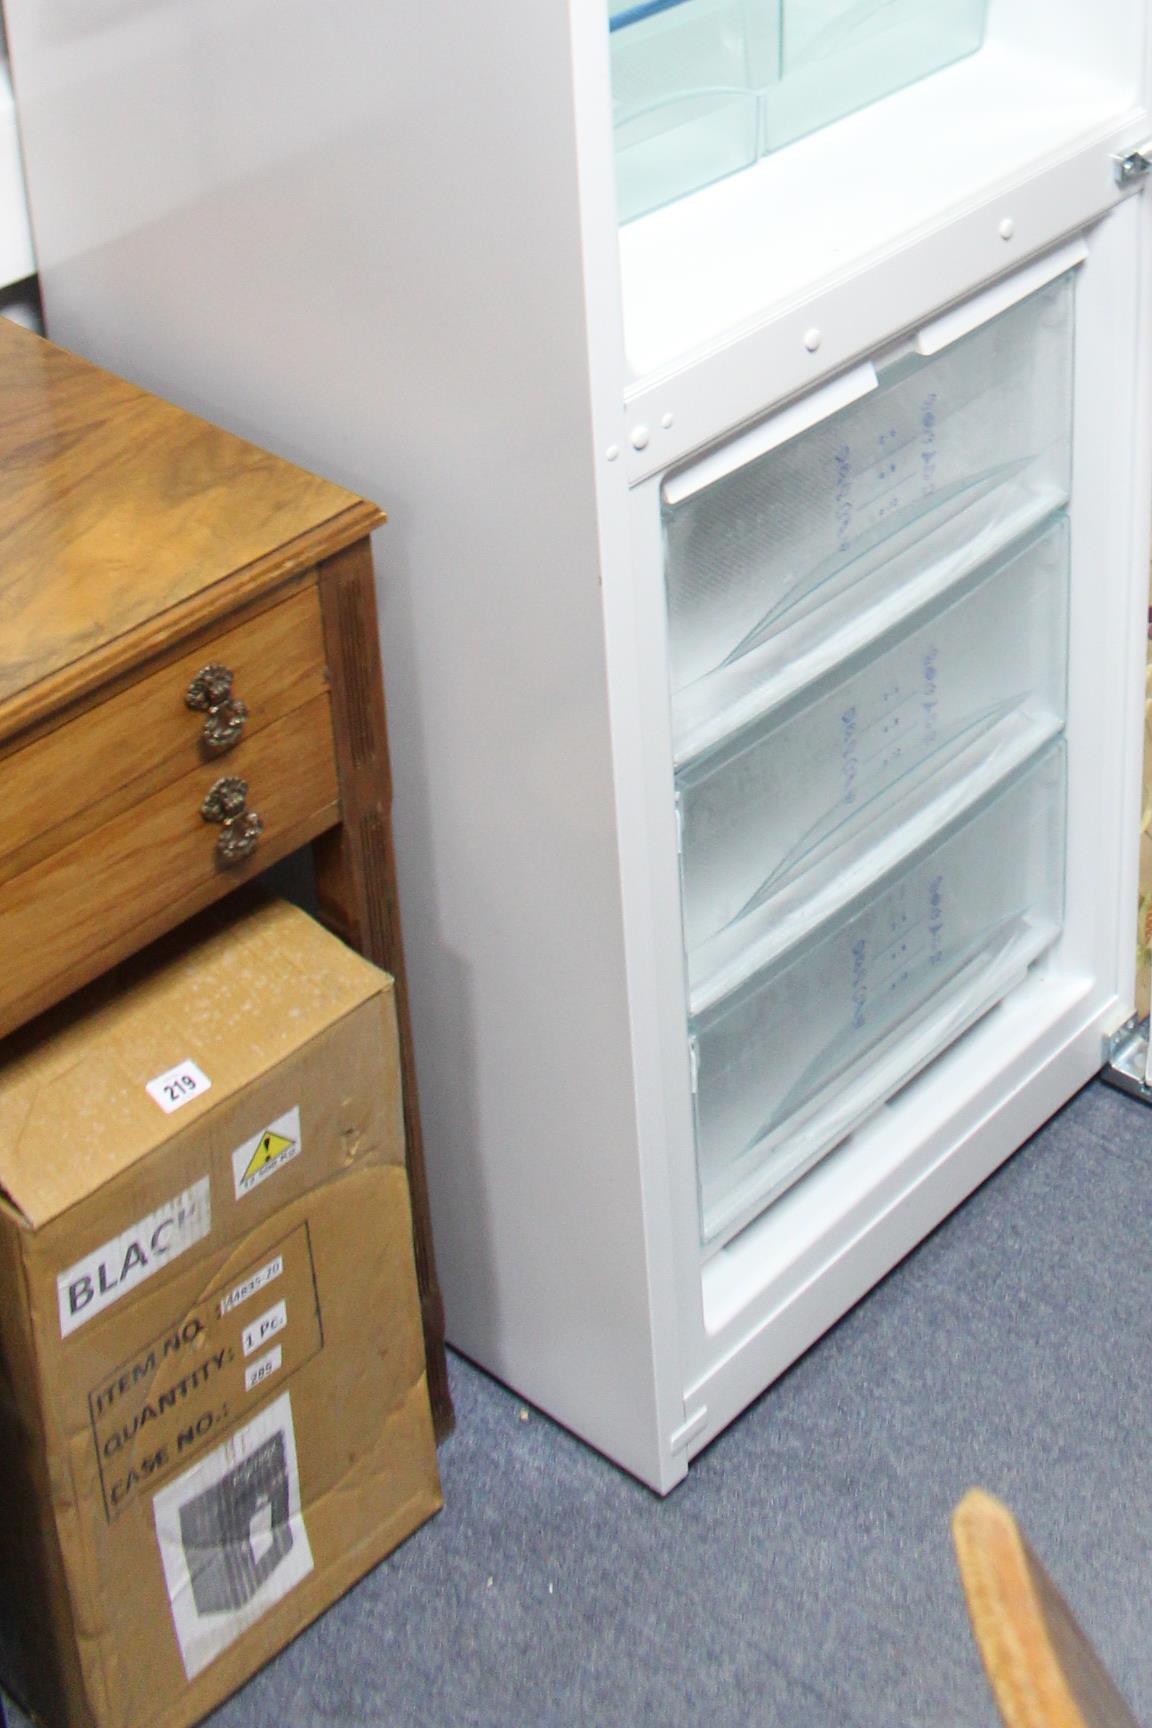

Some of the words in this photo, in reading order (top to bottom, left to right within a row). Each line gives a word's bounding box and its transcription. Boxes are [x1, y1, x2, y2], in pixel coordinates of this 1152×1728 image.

[163, 1075, 197, 1102] 219
[96, 1352, 156, 1412] ITEM
[104, 1347, 235, 1457] QUANTITY:
[111, 1444, 168, 1506] CASE
